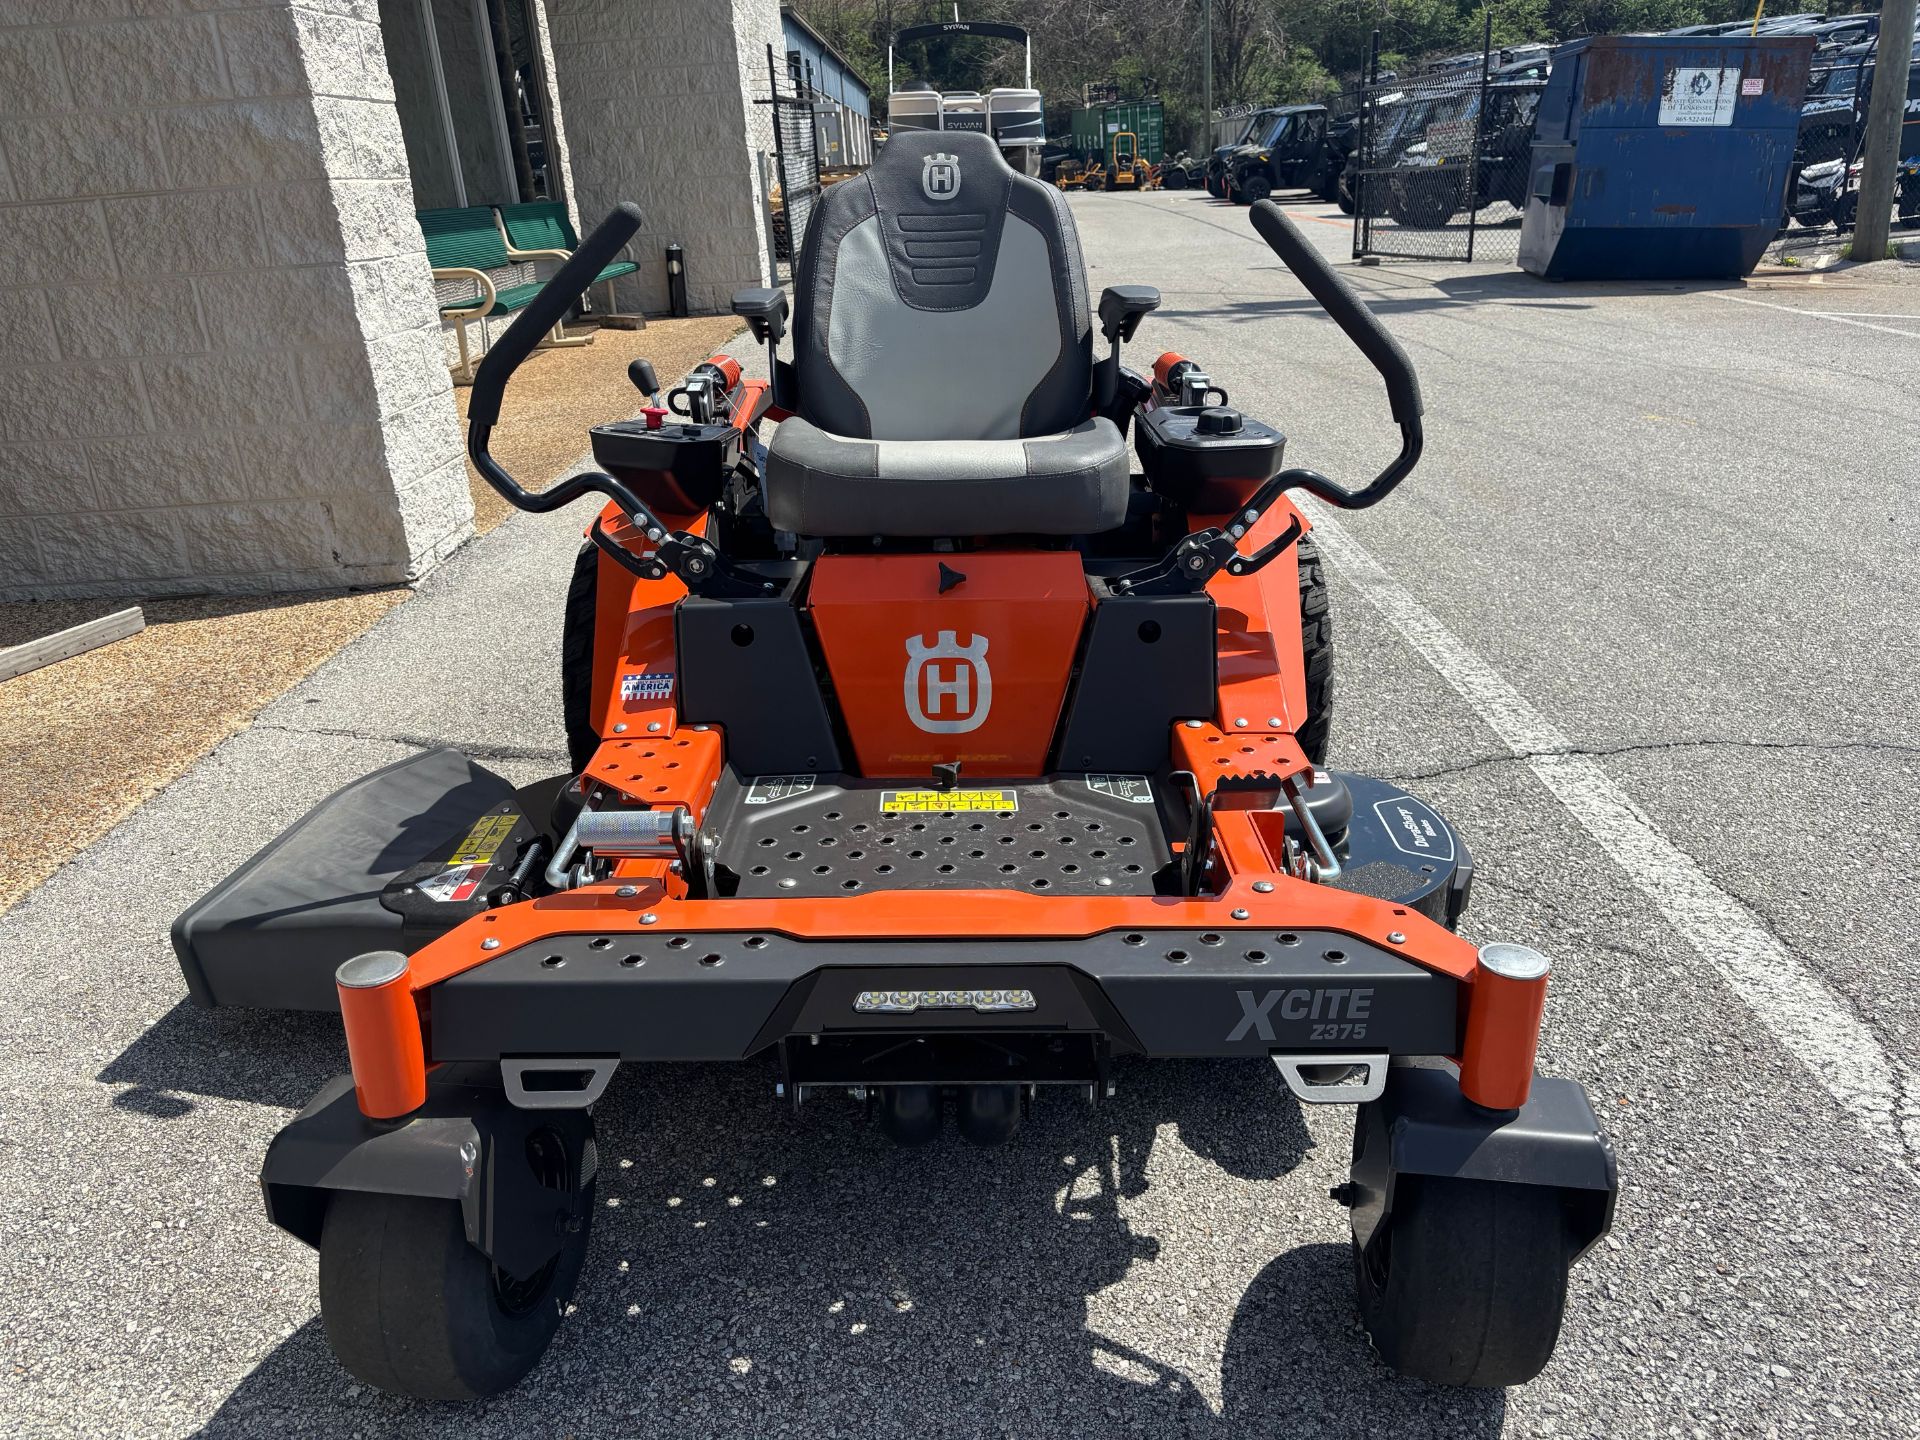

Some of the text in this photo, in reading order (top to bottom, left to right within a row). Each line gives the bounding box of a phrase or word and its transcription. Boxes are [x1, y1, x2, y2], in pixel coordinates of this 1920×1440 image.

[624, 683, 670, 691] AMERICA
[1421, 819, 1437, 837] Blades
[1225, 988, 1375, 1041] XCITE
[1310, 1023, 1367, 1040] Z375
